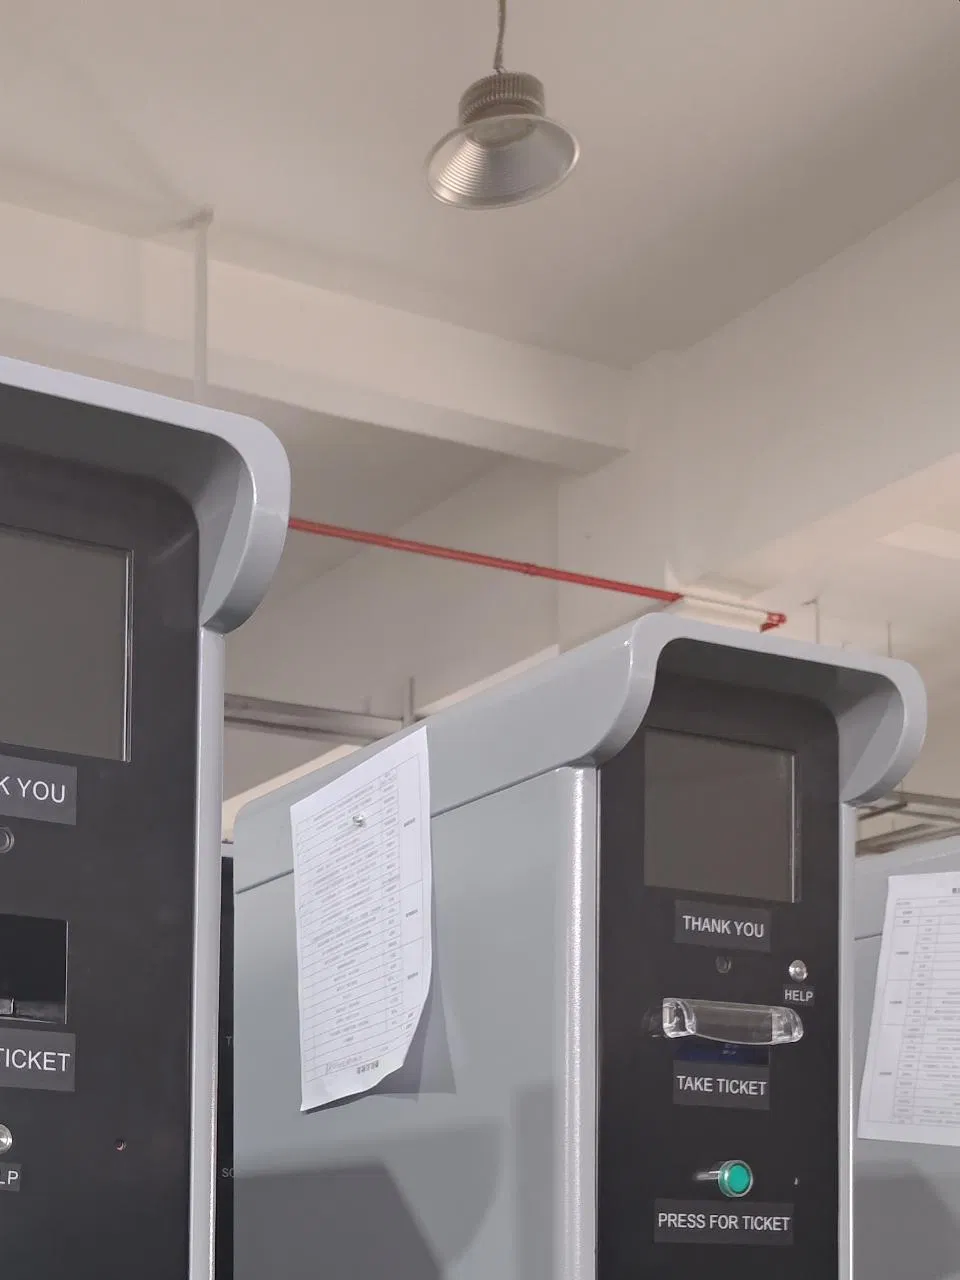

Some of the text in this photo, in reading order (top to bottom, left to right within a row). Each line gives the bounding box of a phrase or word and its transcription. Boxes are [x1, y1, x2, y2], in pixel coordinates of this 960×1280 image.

[17, 777, 67, 804] YOU
[682, 915, 765, 938] THANK YOU
[784, 989, 814, 1003] HELP
[676, 1075, 768, 1096] TAKE TICKET
[658, 1213, 790, 1232] PRESS FOR TICKET
